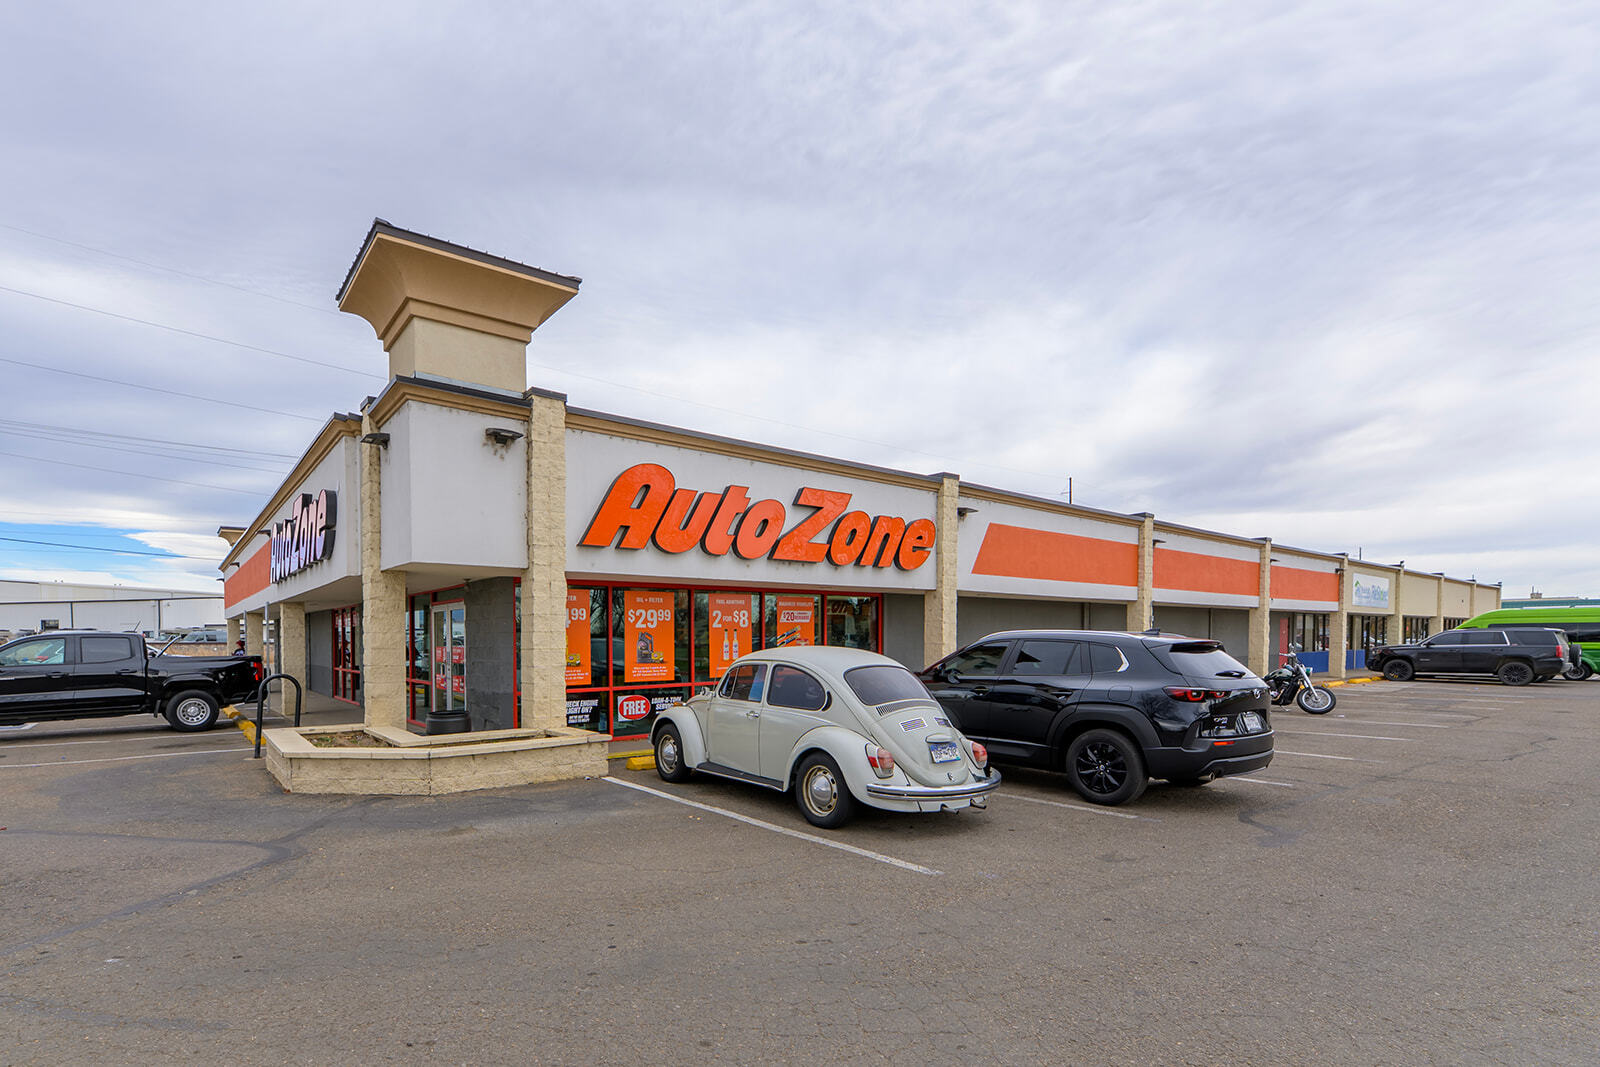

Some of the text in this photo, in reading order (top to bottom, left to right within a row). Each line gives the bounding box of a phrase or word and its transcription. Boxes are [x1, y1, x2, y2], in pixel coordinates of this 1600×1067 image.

[270, 489, 337, 584] AutoZone
[577, 463, 936, 571] AutoZone
[712, 610, 722, 628] 2
[733, 610, 749, 628] $8
[622, 700, 647, 716] FREE
